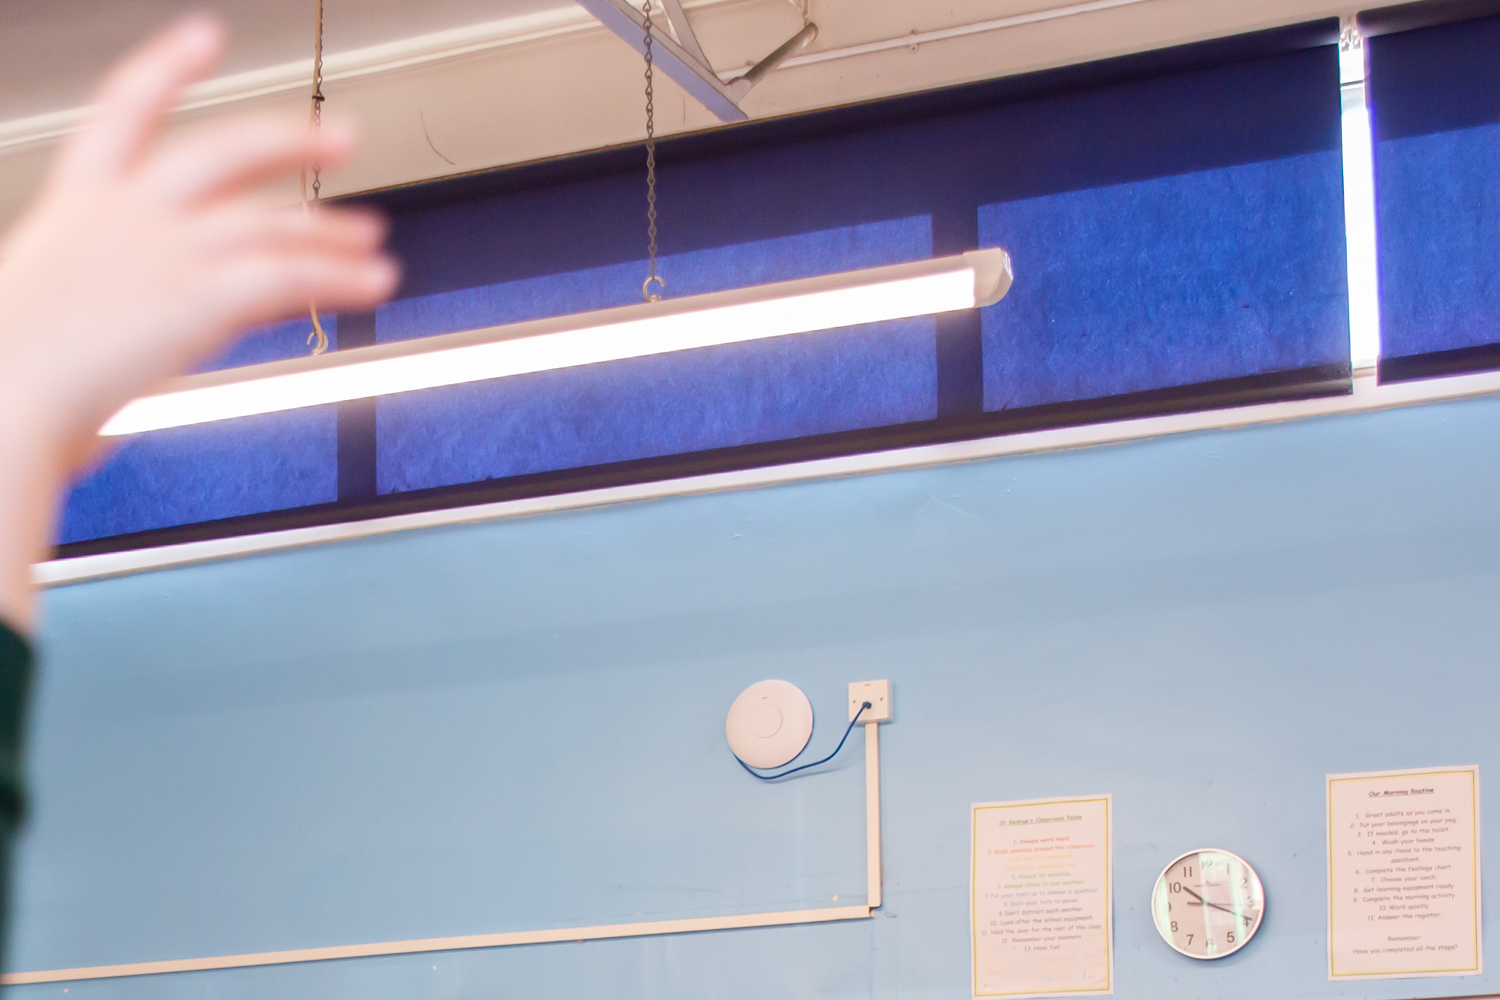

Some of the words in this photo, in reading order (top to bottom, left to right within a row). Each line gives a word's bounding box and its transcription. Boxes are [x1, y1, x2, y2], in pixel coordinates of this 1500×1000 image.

[1383, 789, 1408, 797] Morning
[1184, 867, 1192, 877] 11
[1227, 864, 1229, 874] 1
[1169, 882, 1181, 893] 10
[1241, 878, 1248, 888] 2
[1171, 921, 1178, 932] 8
[1187, 934, 1194, 945] 7
[1227, 932, 1234, 942] 5
